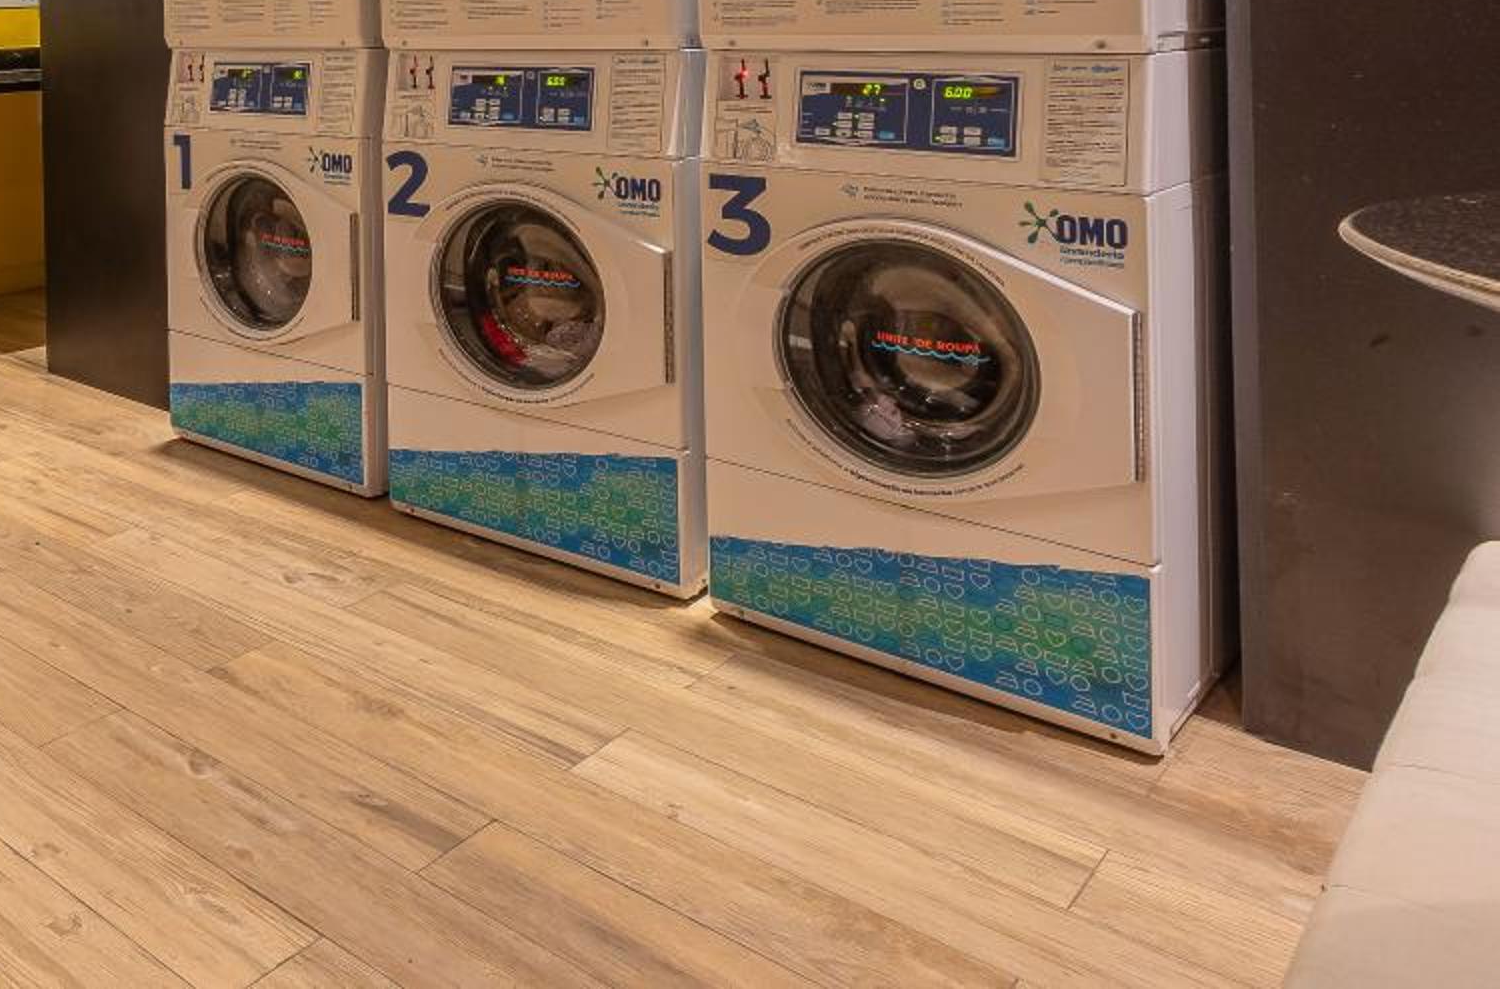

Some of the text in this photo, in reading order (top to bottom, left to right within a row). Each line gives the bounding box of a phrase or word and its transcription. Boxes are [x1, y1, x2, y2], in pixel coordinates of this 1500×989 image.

[173, 134, 192, 190] 1
[322, 152, 353, 174] OMO
[386, 150, 431, 218] 2
[613, 176, 661, 202] OMO
[707, 173, 772, 257] 3
[1056, 214, 1128, 249] OMO
[937, 340, 981, 354] ROUPA
